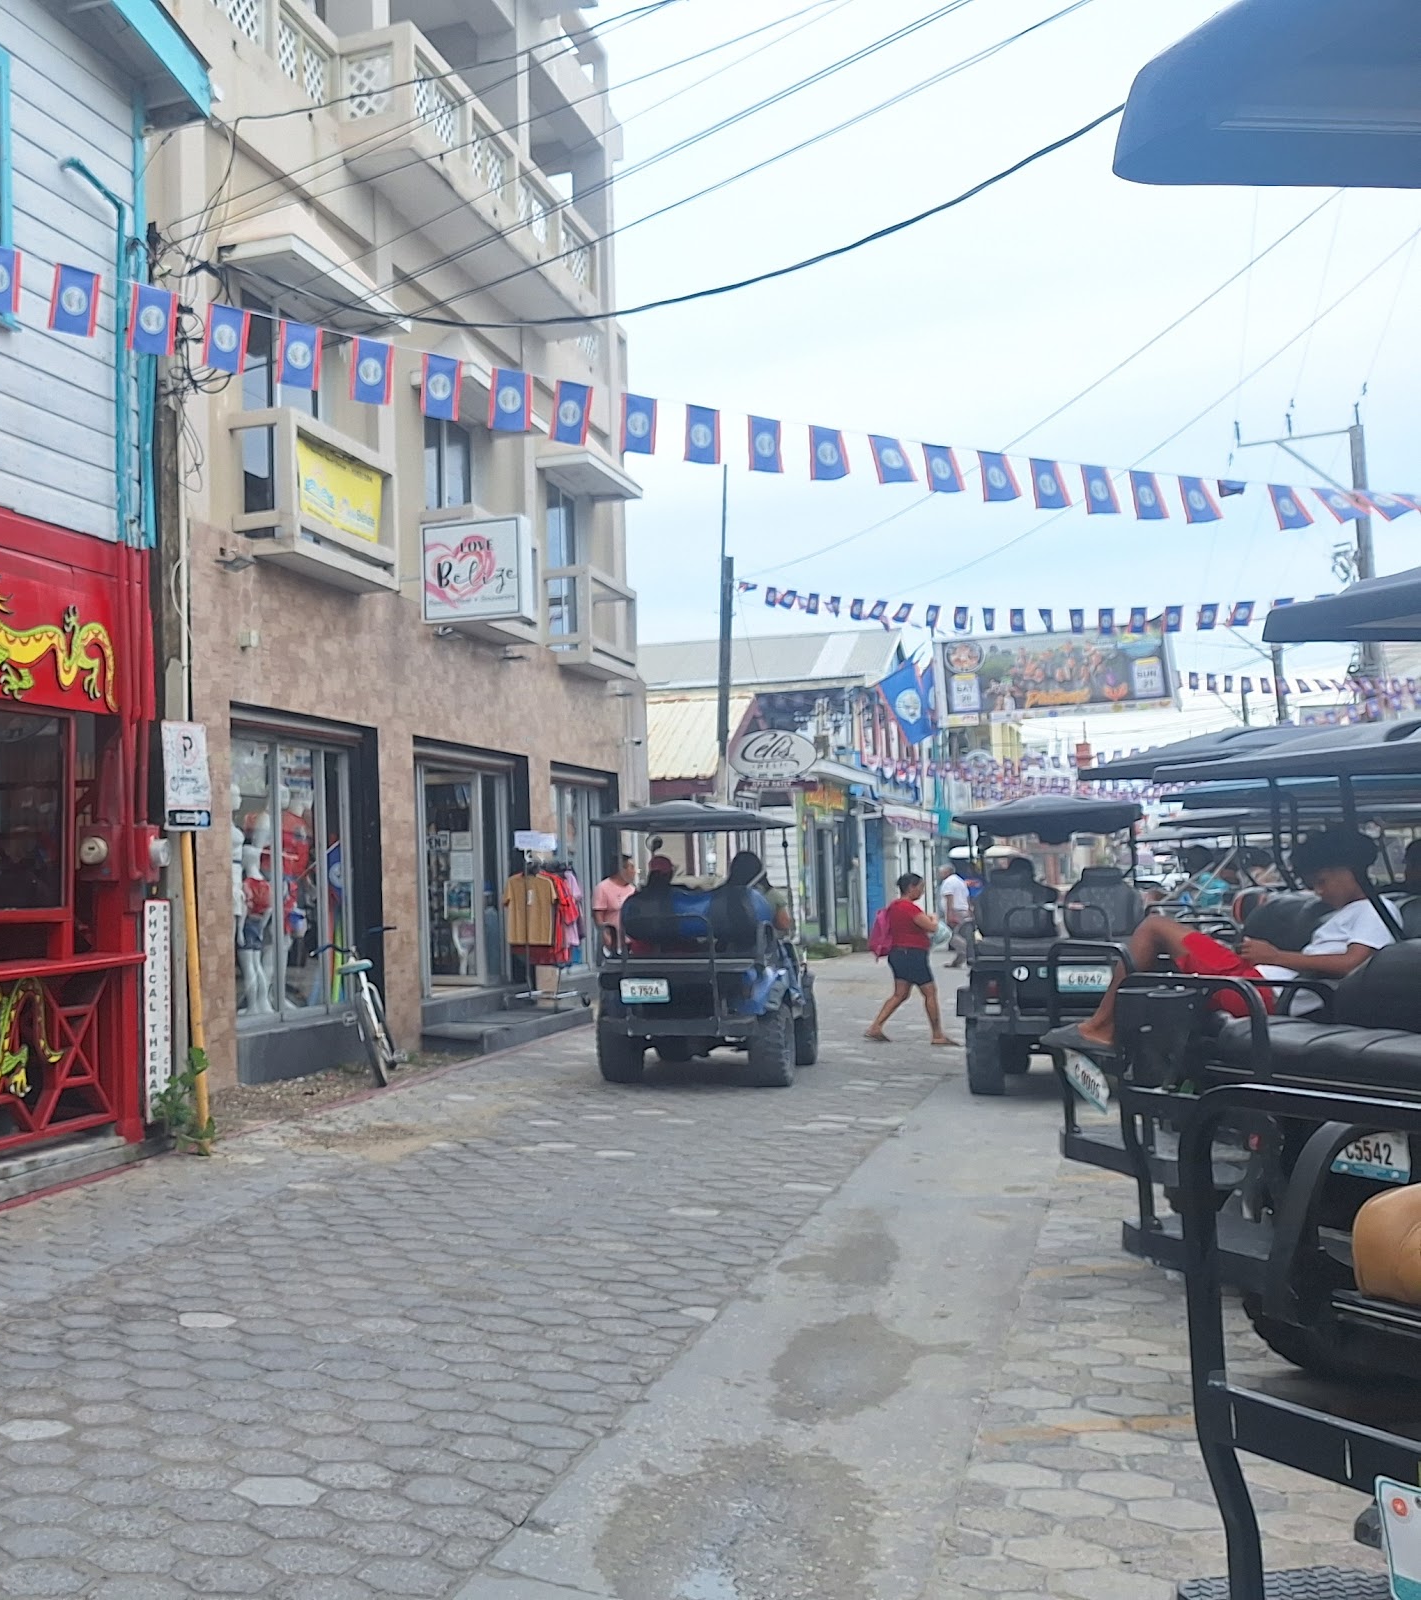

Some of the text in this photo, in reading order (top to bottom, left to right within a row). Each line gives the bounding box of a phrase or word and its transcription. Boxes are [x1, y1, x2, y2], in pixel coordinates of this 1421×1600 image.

[460, 539, 494, 553] LOVE
[437, 560, 518, 595] Belize
[149, 905, 158, 1104] PHYSICAL THERAP
